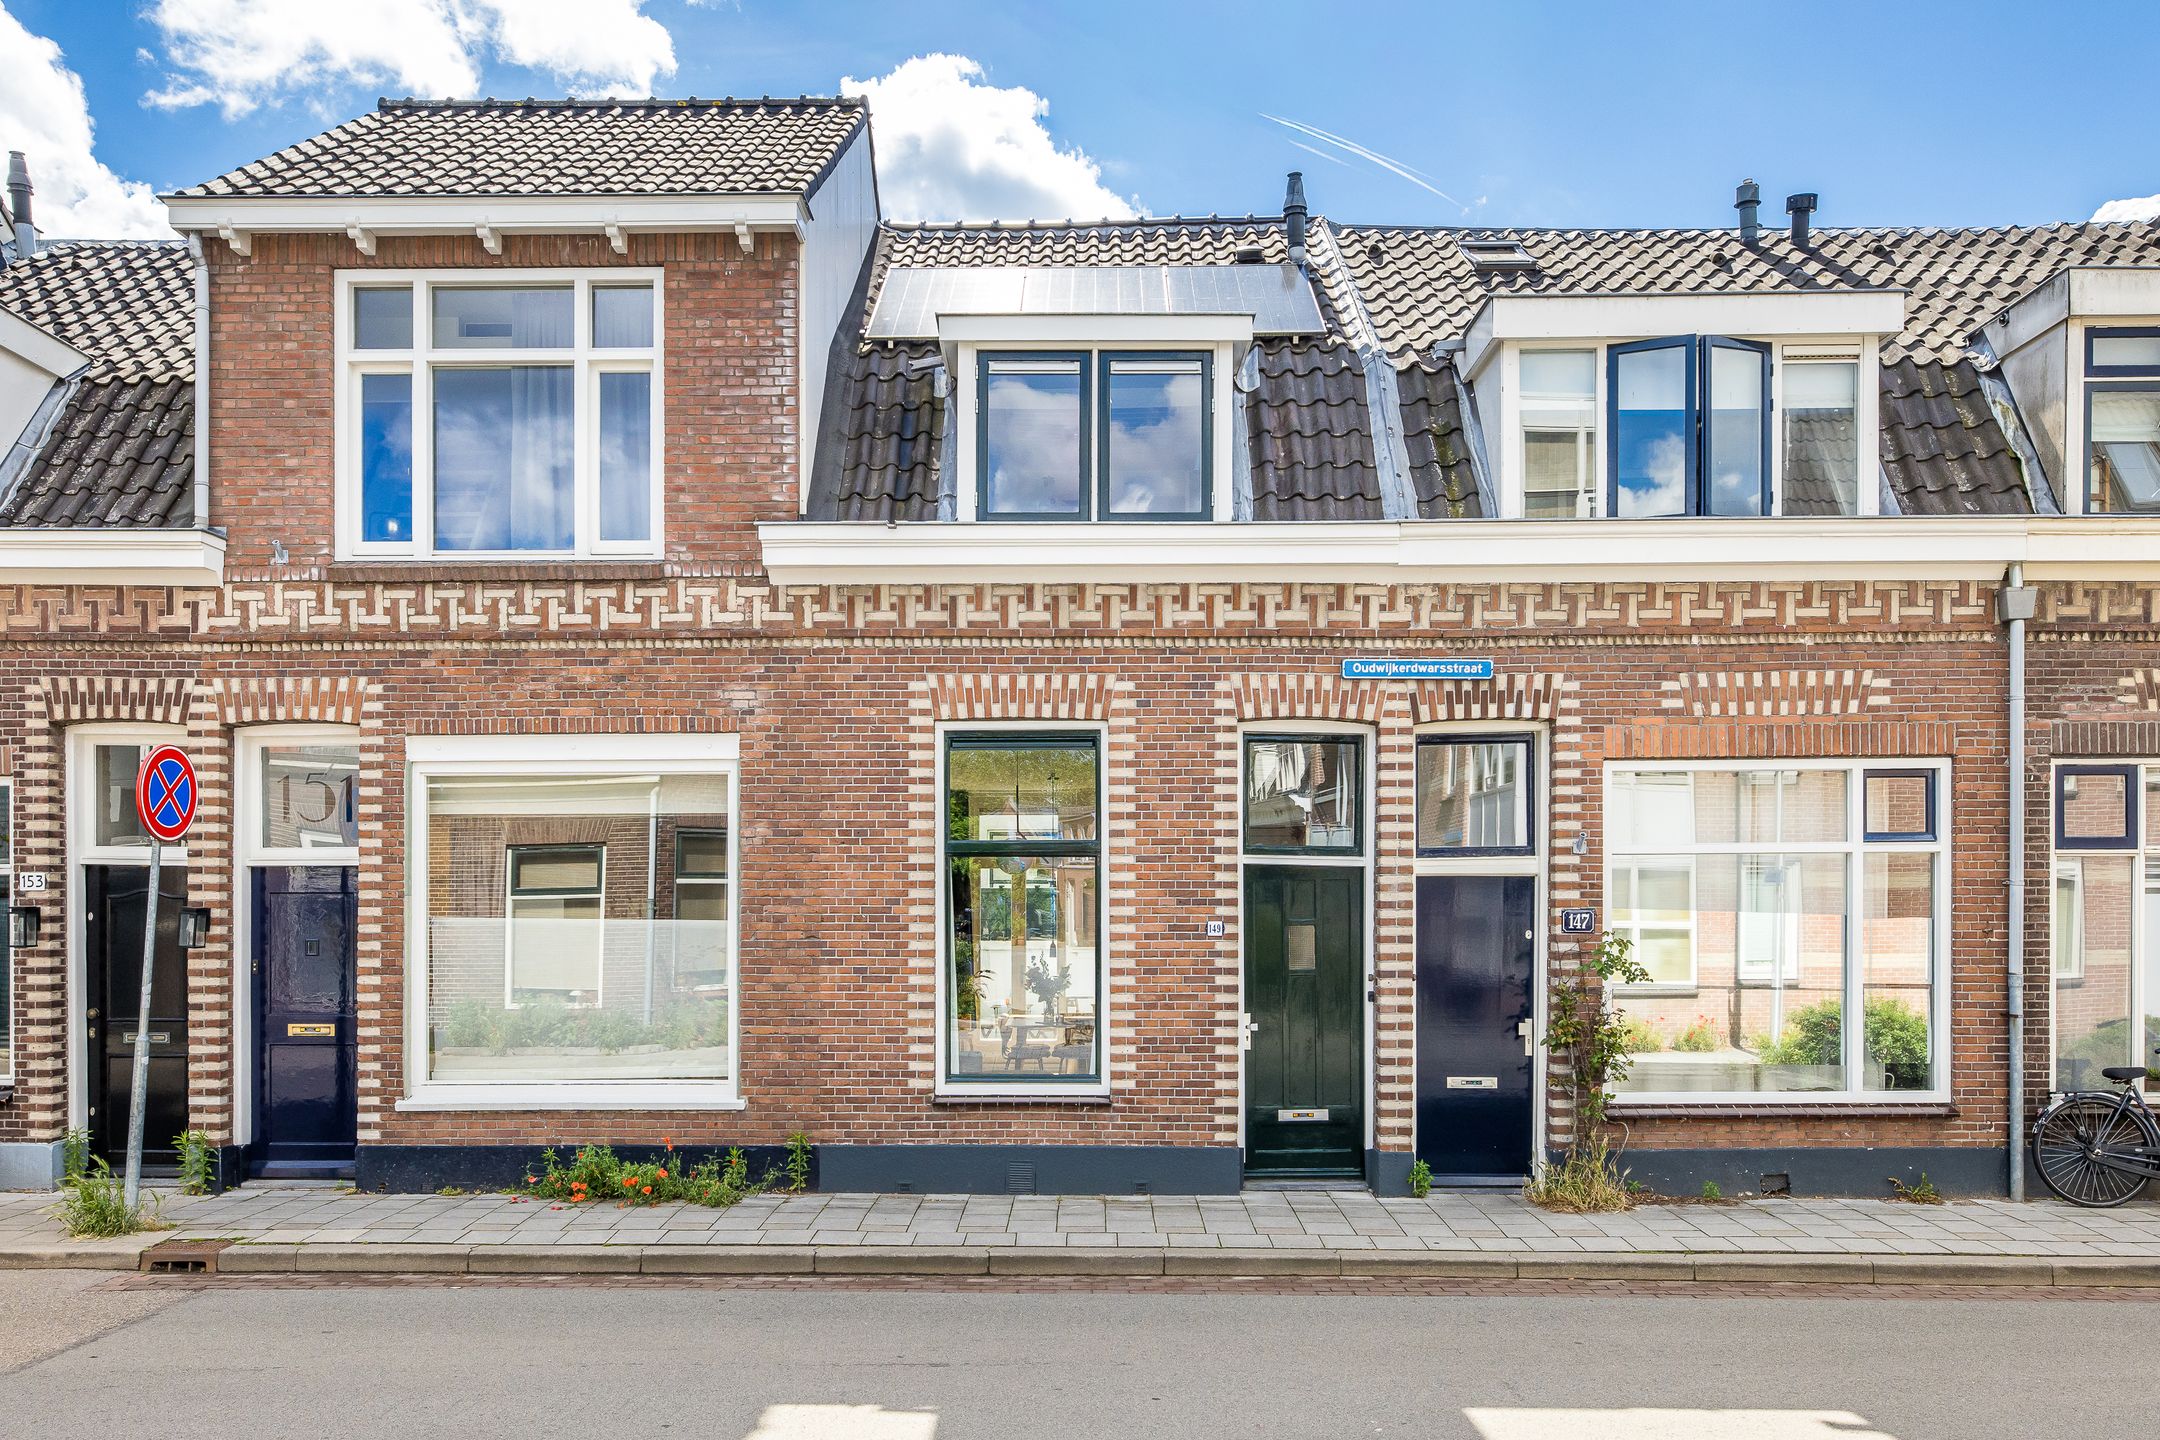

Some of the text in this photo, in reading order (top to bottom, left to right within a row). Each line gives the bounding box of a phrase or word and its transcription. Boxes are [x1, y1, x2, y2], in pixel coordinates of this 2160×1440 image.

[1352, 662, 1483, 676] Oudwijkerdwarsstraat
[277, 772, 353, 823] 151
[21, 875, 43, 888] 153
[1568, 913, 1590, 929] 147
[1209, 924, 1221, 933] 149
